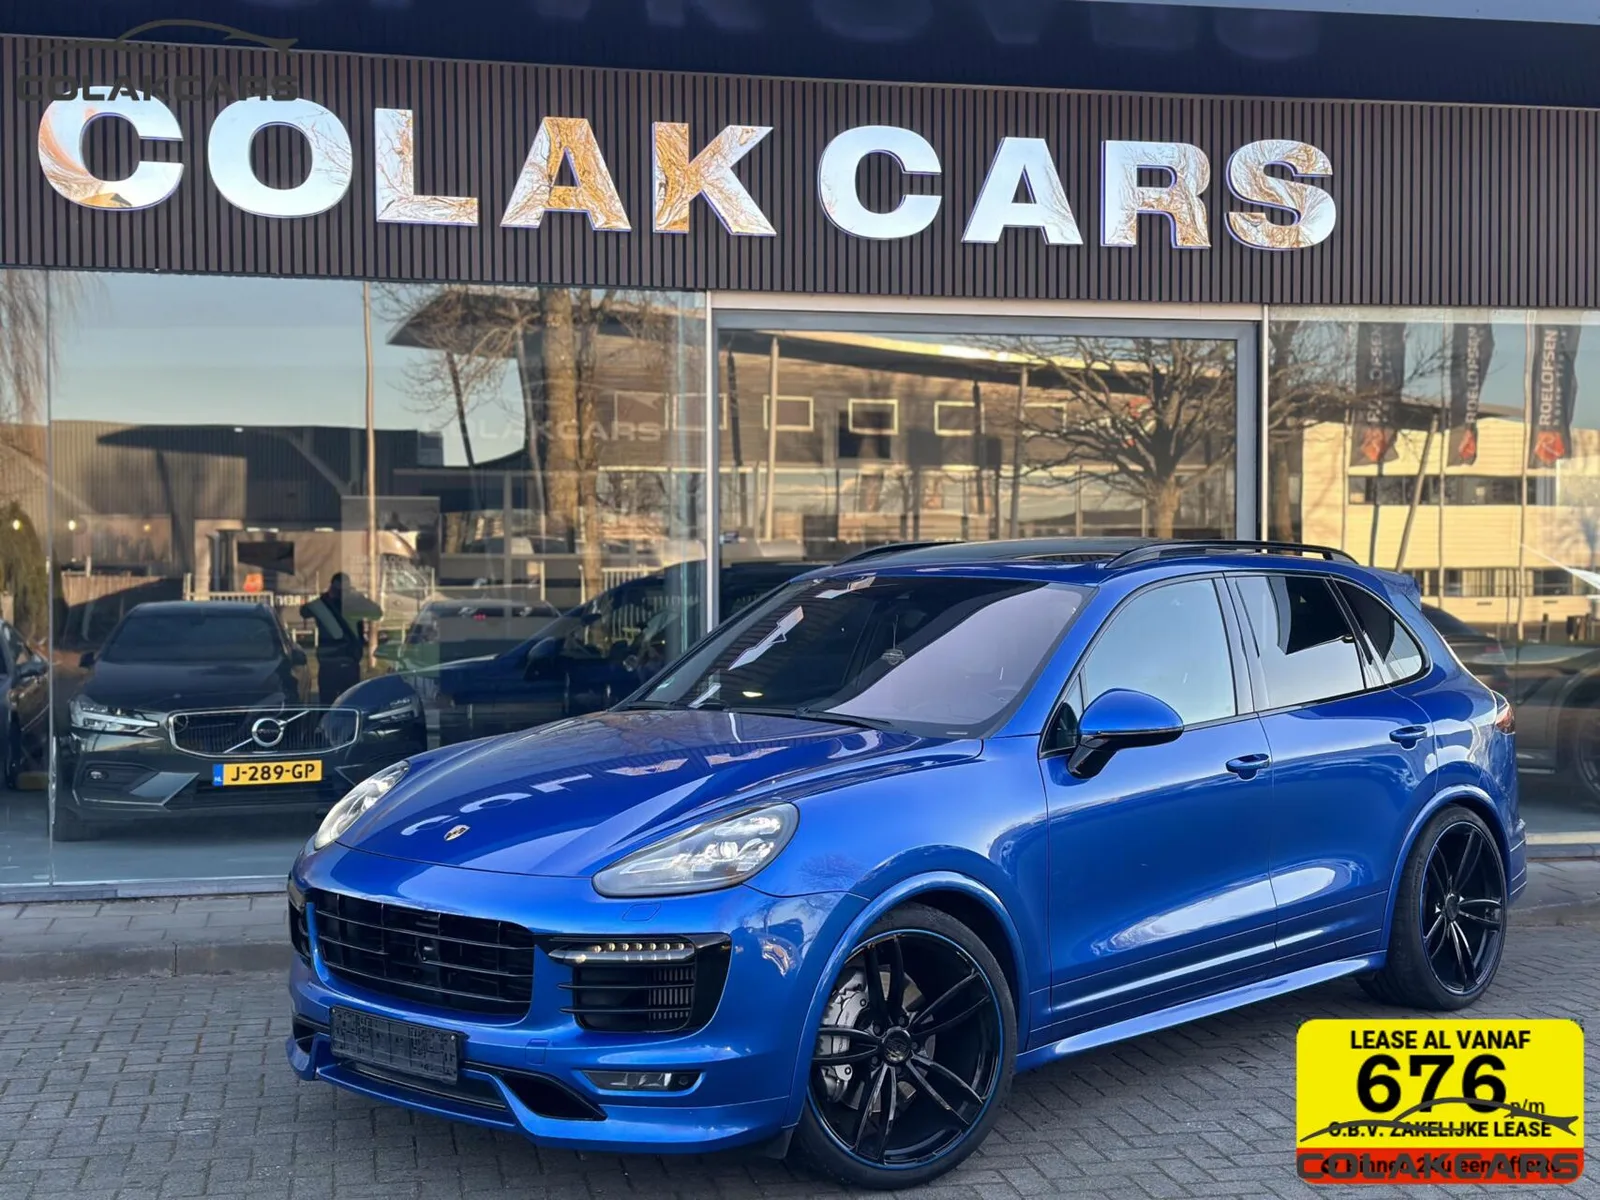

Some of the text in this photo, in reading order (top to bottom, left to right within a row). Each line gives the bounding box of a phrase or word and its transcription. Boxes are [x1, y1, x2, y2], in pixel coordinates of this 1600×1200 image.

[38, 85, 1337, 251] COLAK CARS
[1367, 324, 1382, 422] ROOFSEN
[1539, 329, 1558, 426] ROELOFSEN
[422, 420, 660, 441] OLAKCARS
[231, 763, 315, 781] J-289-GP
